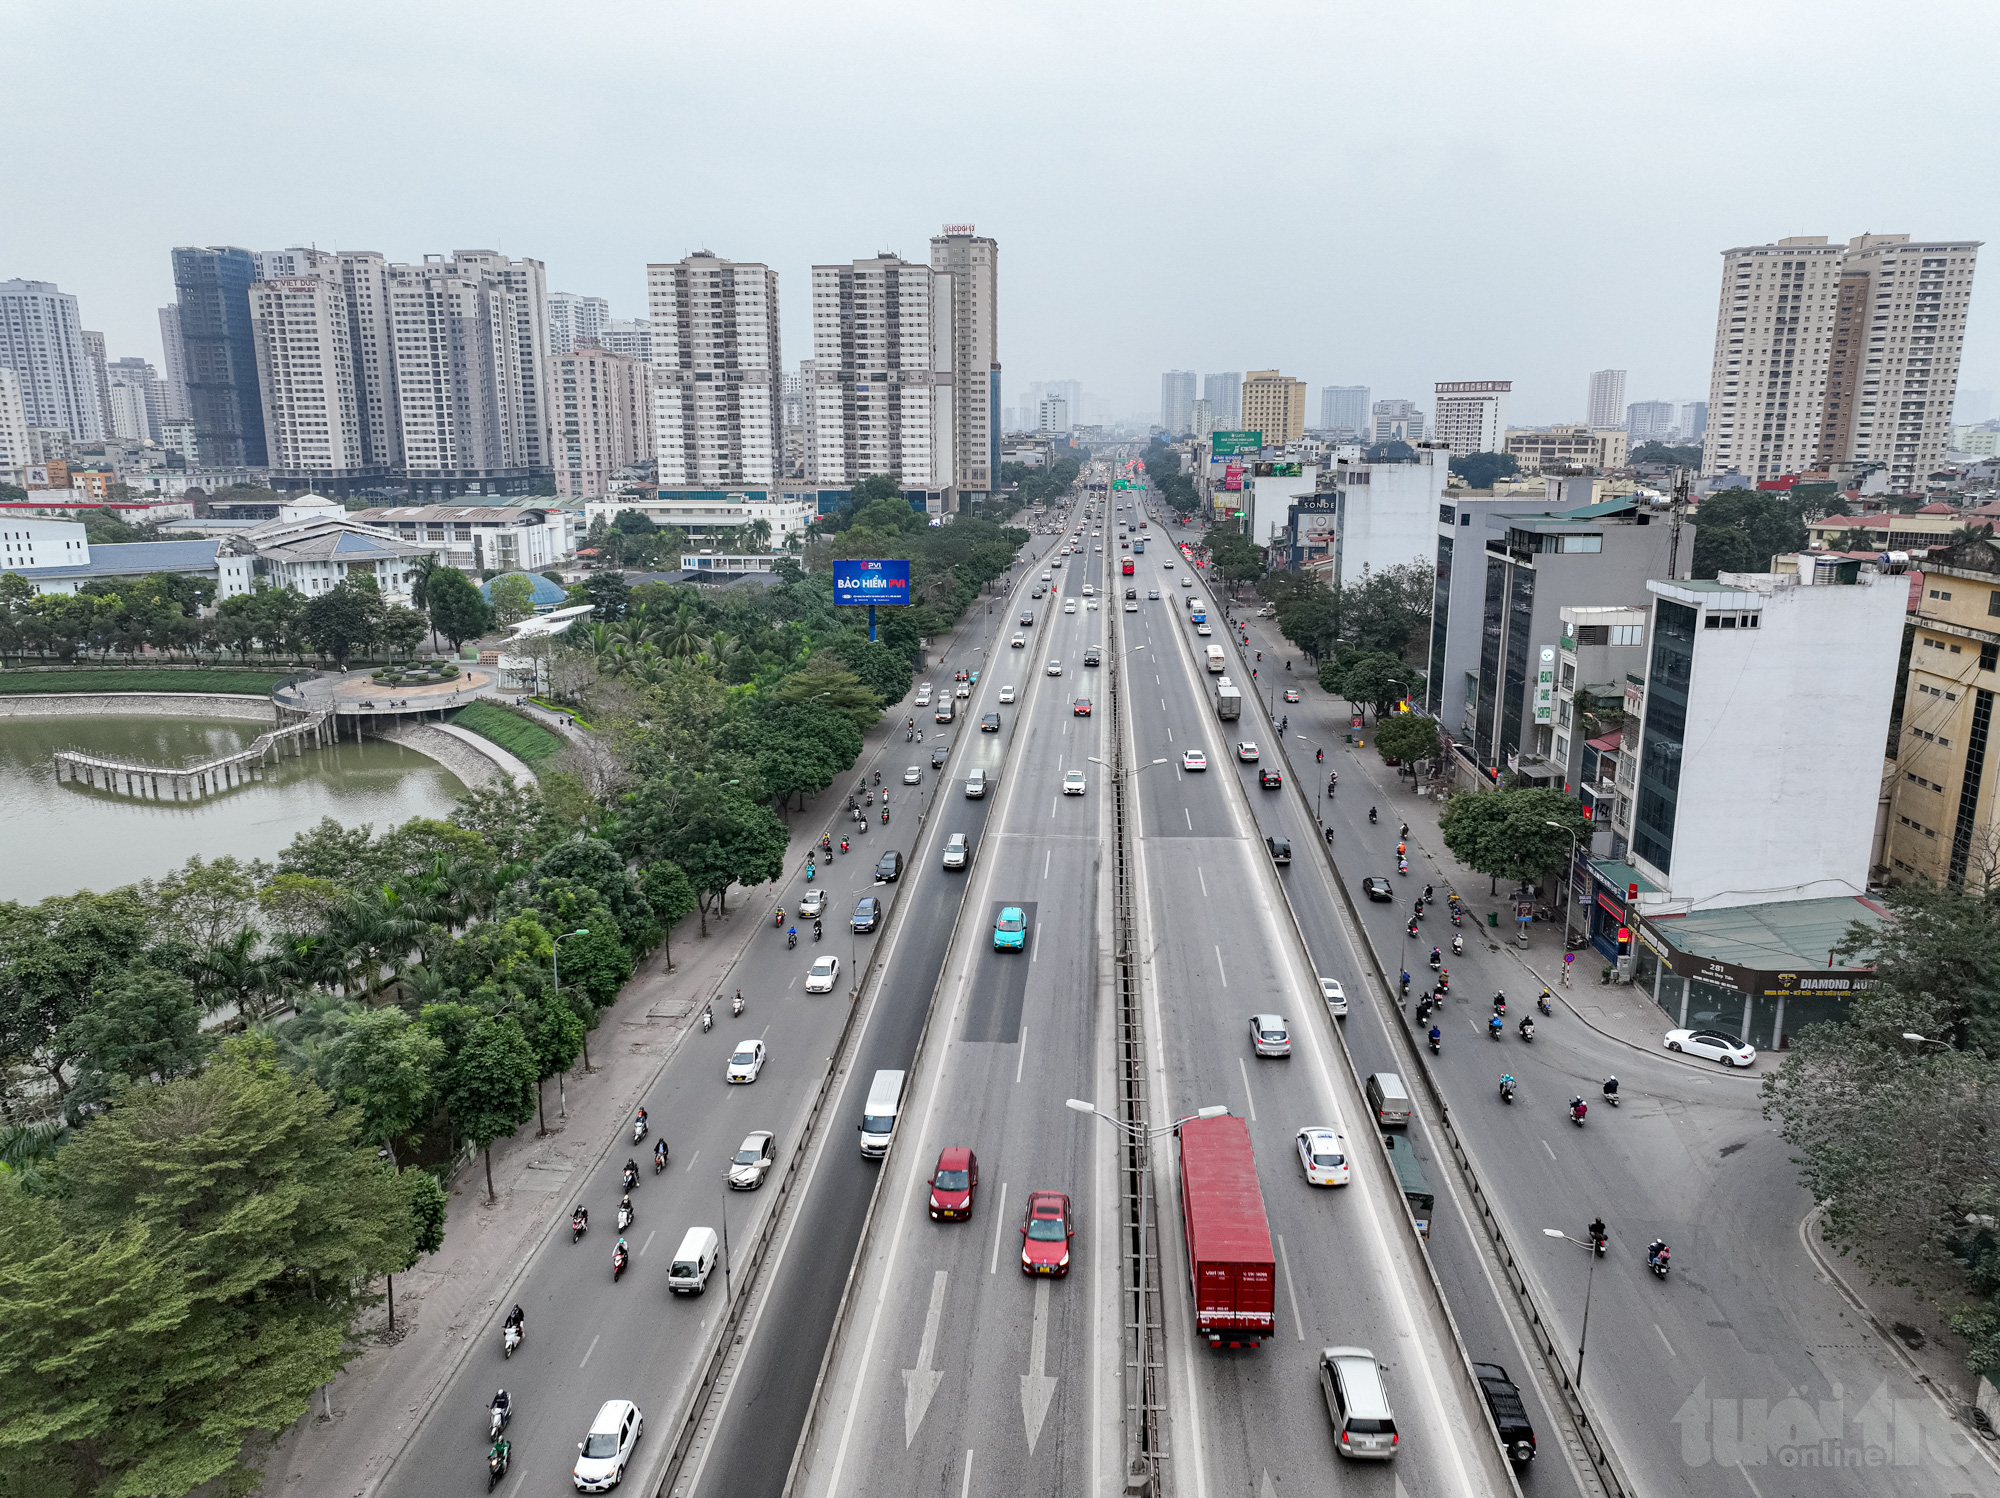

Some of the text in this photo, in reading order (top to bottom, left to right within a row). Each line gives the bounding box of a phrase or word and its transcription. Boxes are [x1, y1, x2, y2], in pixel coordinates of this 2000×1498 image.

[837, 575, 906, 588] BẢO HIỂM PVI
[1709, 963, 1725, 973] 281
[1800, 979, 1850, 990] DIAMOND
